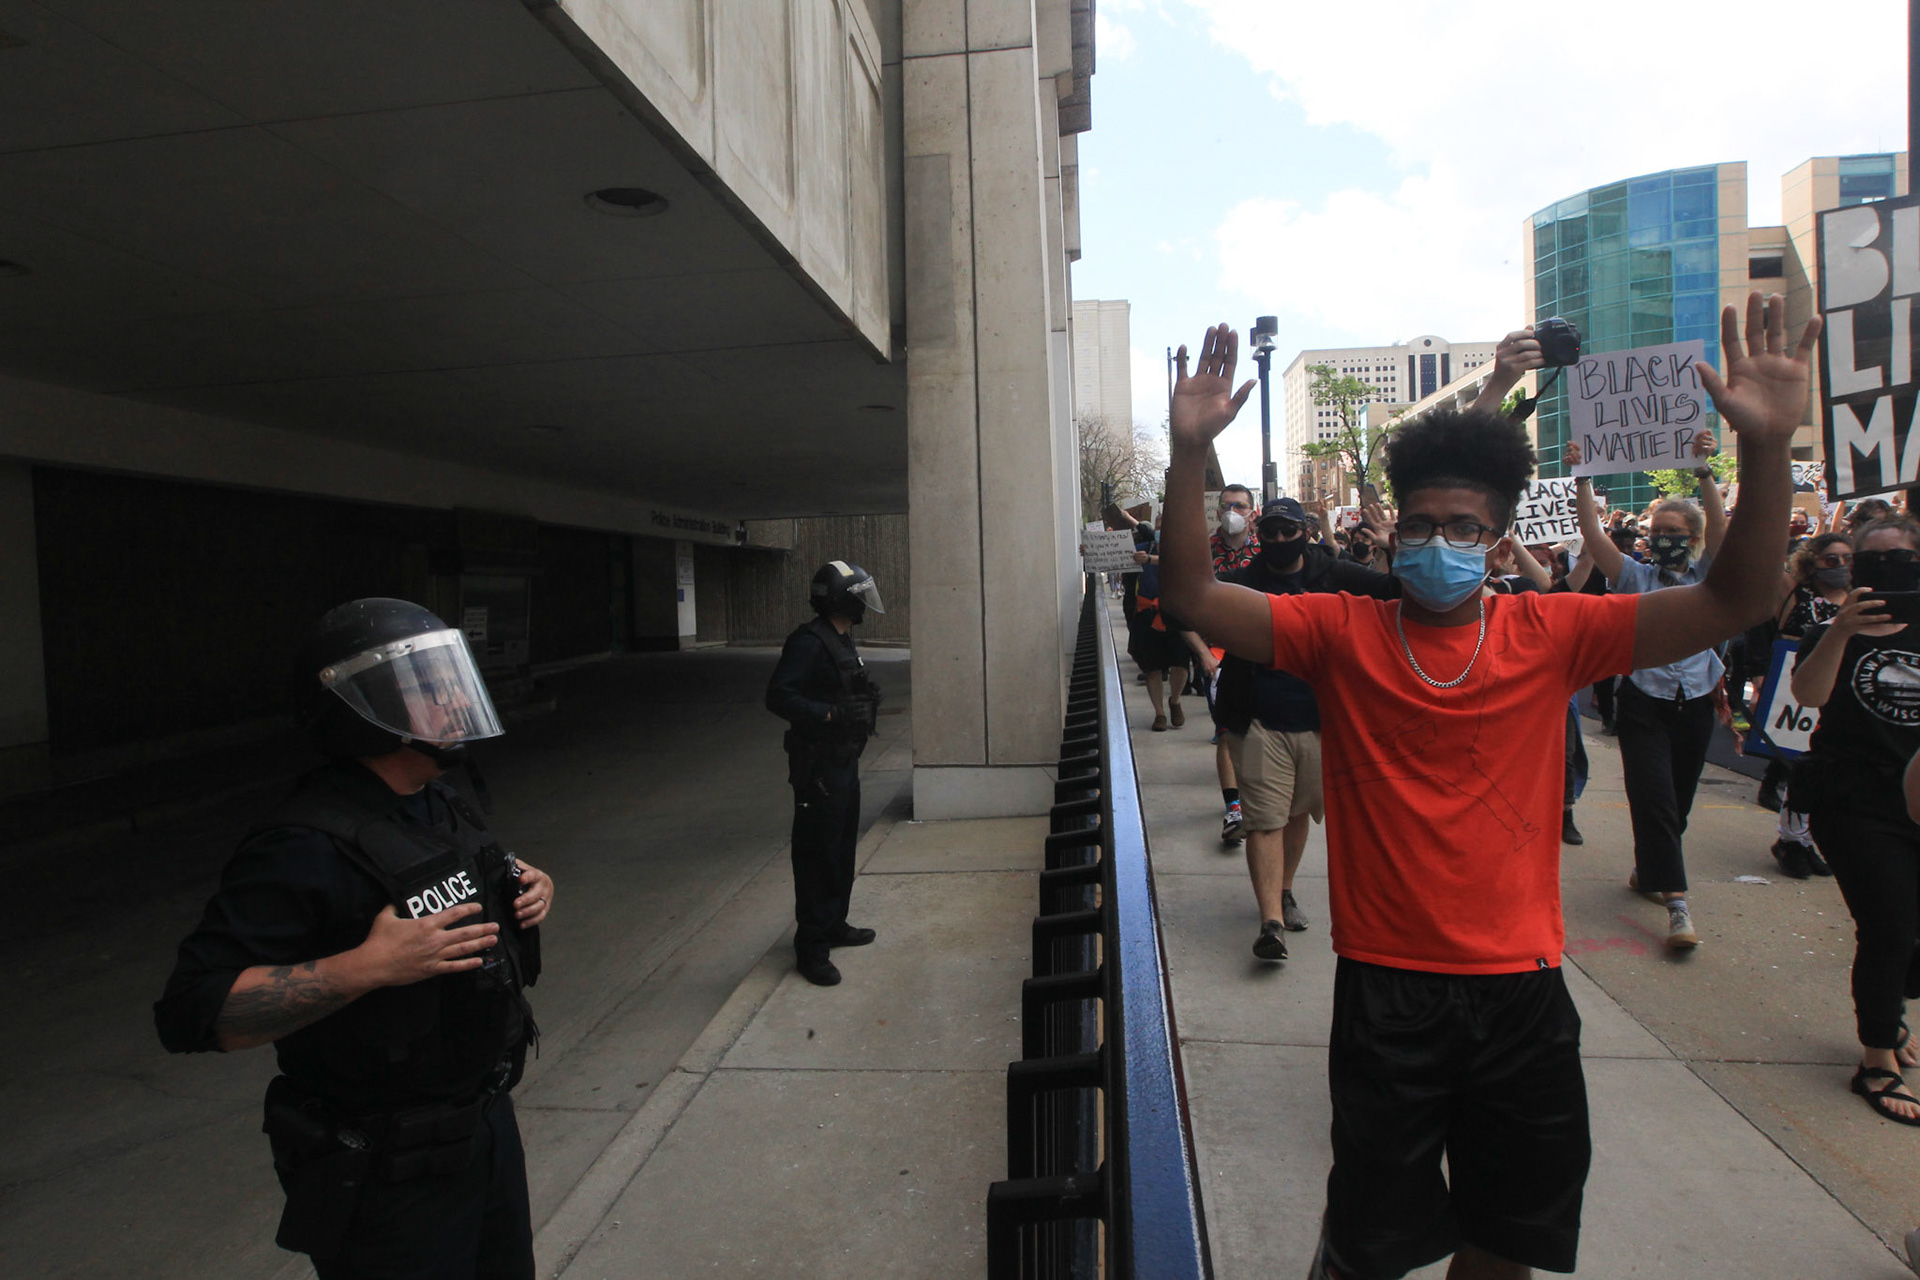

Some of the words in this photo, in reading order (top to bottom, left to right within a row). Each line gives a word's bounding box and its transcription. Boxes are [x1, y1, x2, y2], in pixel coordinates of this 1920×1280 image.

[1826, 297, 1912, 398] LI
[1576, 354, 1697, 400] BLACK
[1595, 393, 1700, 428] LIVES
[1584, 428, 1698, 465] MATTER
[1525, 480, 1577, 500] LACK
[1515, 499, 1577, 520] IVES
[1775, 704, 1812, 732] No
[406, 870, 478, 919] POLICE
